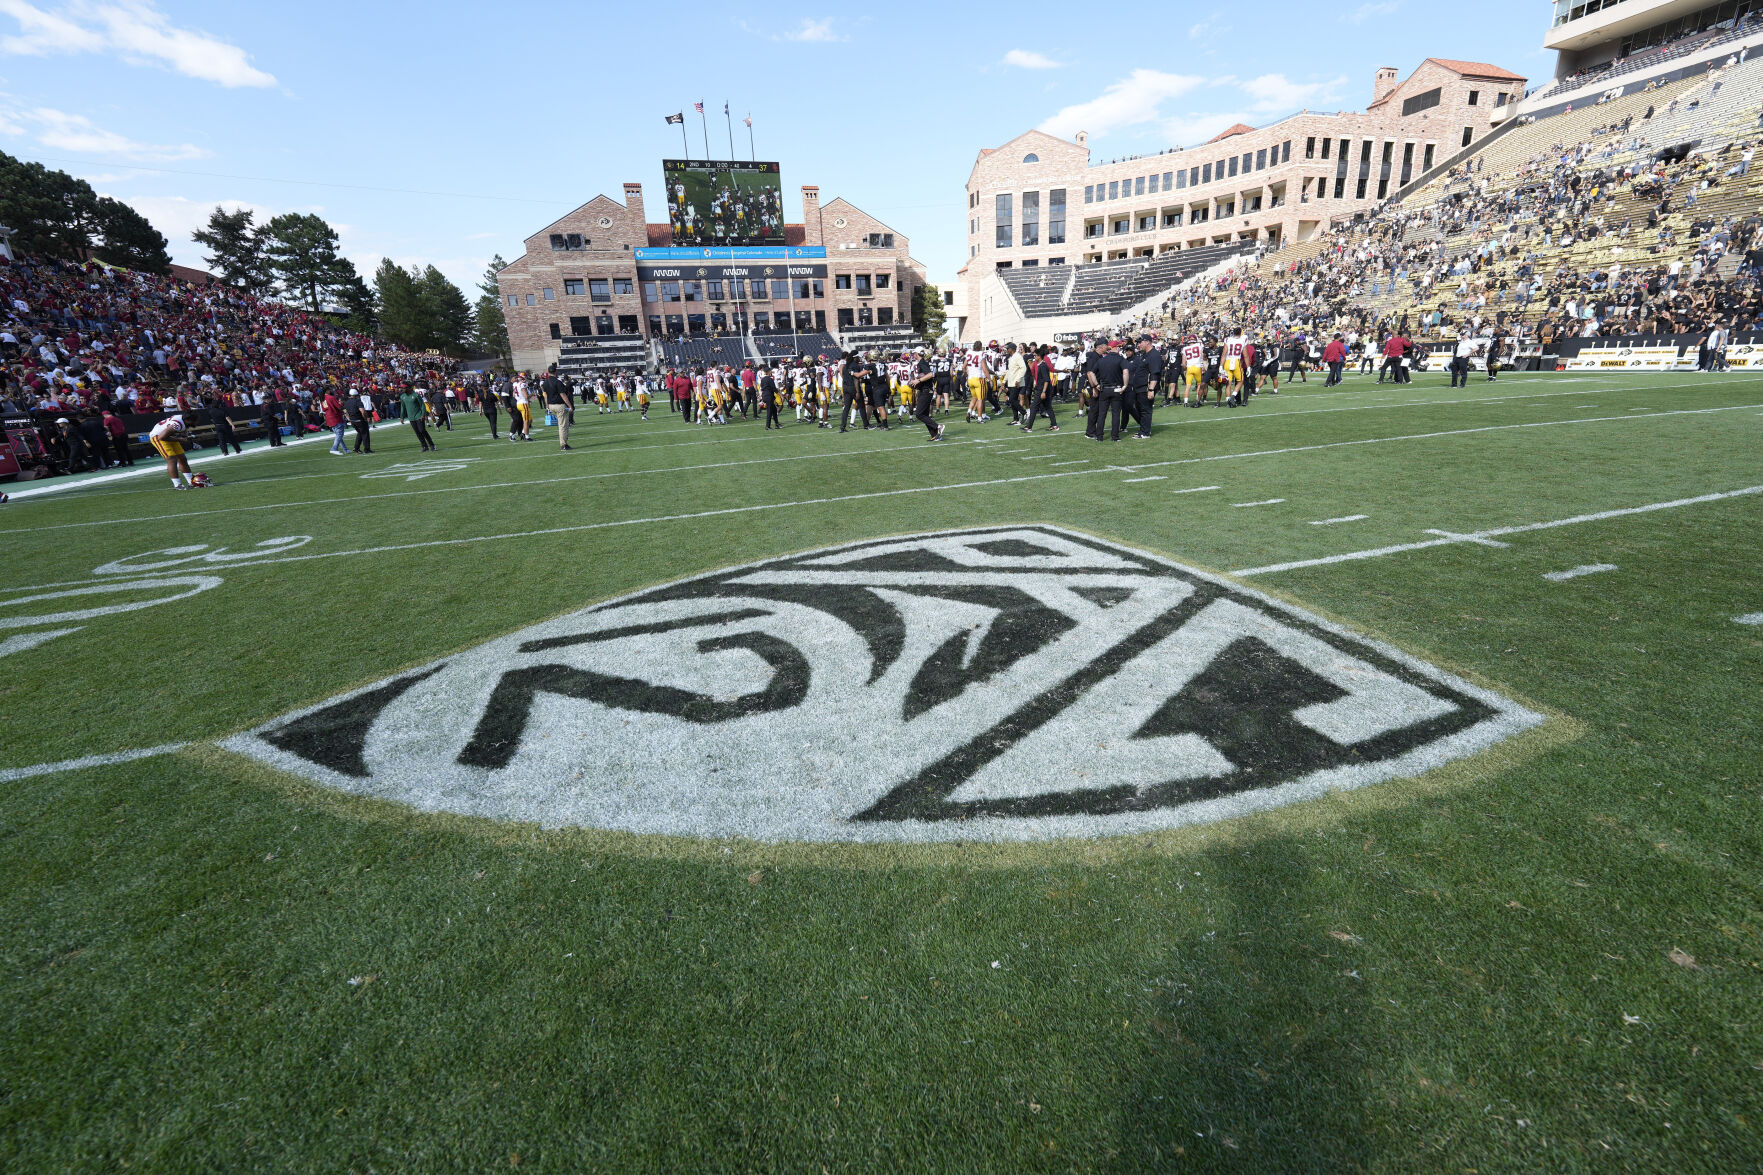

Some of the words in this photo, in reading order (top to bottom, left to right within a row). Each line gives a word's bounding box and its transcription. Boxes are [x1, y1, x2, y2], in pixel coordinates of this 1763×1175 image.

[676, 162, 685, 170] 14
[758, 164, 768, 172] 37
[1185, 346, 1200, 360] 59
[1229, 343, 1242, 356] 18
[937, 361, 950, 372] 26
[966, 354, 979, 367] 24
[899, 369, 909, 381] 16
